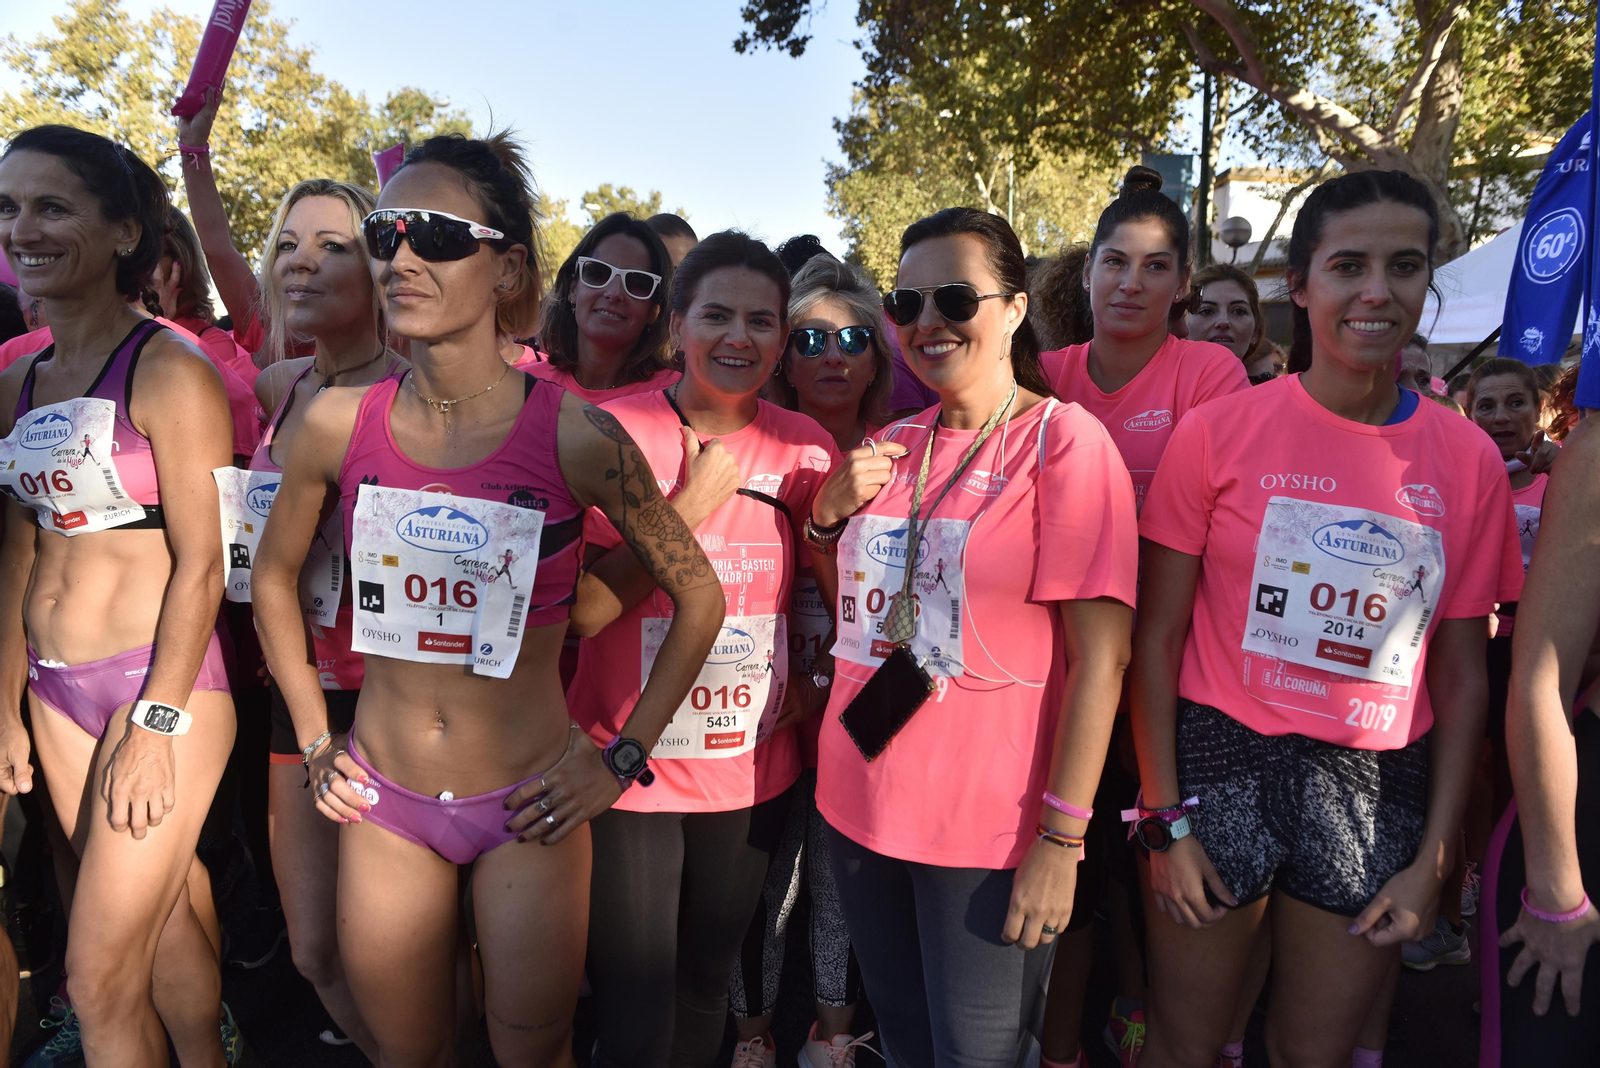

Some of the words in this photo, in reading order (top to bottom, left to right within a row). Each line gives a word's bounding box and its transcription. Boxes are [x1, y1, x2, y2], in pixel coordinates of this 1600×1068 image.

[1128, 416, 1171, 429] ASTURIANA
[22, 428, 68, 443] ASTURIANA
[51, 447, 76, 457] Carrera
[66, 456, 85, 469] Mujer
[19, 469, 73, 495] 016
[481, 482, 502, 490] Club
[503, 484, 548, 492] Atletismo
[1260, 473, 1337, 493] OYSHO
[513, 496, 544, 507] betta
[103, 509, 131, 521] ZURICH
[402, 519, 480, 545] ASTURIANA
[1319, 530, 1398, 561] ASTURIANA
[453, 554, 489, 570] Carrera
[741, 560, 775, 571] GASTEIZ
[475, 569, 497, 586] Mujer
[716, 572, 754, 583] MADRID
[1373, 567, 1406, 584] Carrera
[404, 573, 478, 609] 016
[1389, 583, 1413, 600] Mujer
[1310, 582, 1388, 623] 016
[305, 608, 329, 618] ZURICH
[436, 612, 443, 627] 1
[362, 627, 402, 644] OYSHO
[1256, 628, 1299, 647] OYSHO
[1323, 620, 1364, 640] 2014
[433, 639, 465, 648] Santander
[790, 633, 822, 654] 01
[841, 636, 860, 650] OYSHO
[1333, 648, 1365, 661] Santander
[316, 659, 337, 669] 017
[474, 657, 502, 668] URICH
[735, 662, 759, 672] Carrera
[750, 671, 767, 683] Mujer
[1284, 676, 1327, 697] CORUÑA
[690, 684, 751, 711] 016
[706, 715, 737, 728] 5431
[1345, 698, 1397, 732] 2019
[718, 737, 742, 745] Santander
